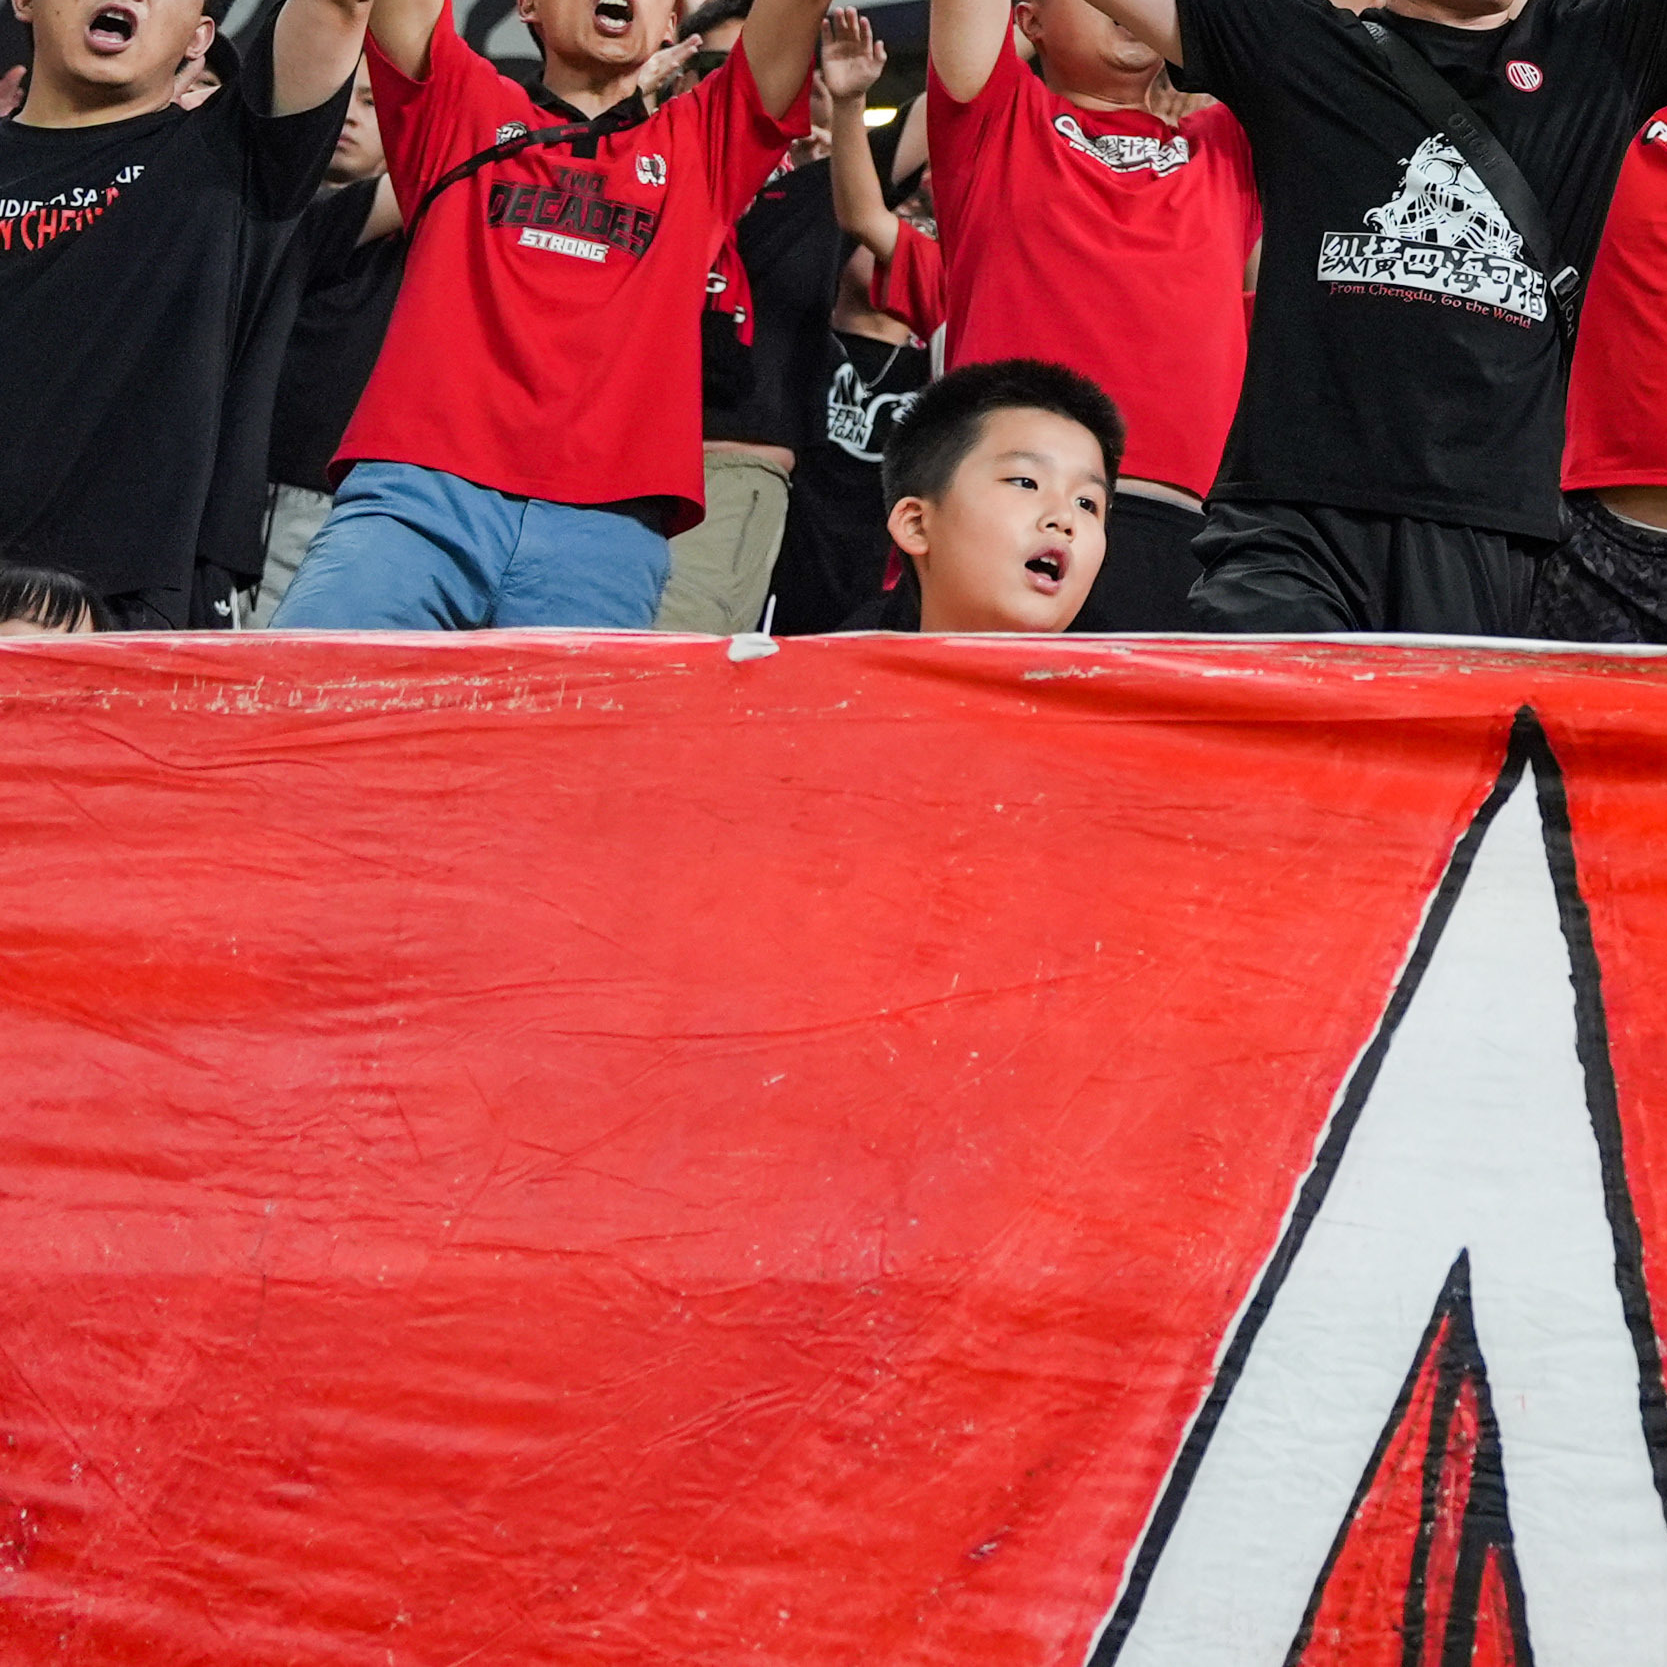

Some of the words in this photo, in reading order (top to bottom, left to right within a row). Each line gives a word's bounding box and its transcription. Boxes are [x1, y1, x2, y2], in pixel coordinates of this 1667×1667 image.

[487, 181, 657, 259] DECADES
[518, 227, 610, 263] STRONG
[1330, 282, 1365, 295] From
[1465, 297, 1491, 317] the
[1491, 304, 1532, 329] World
